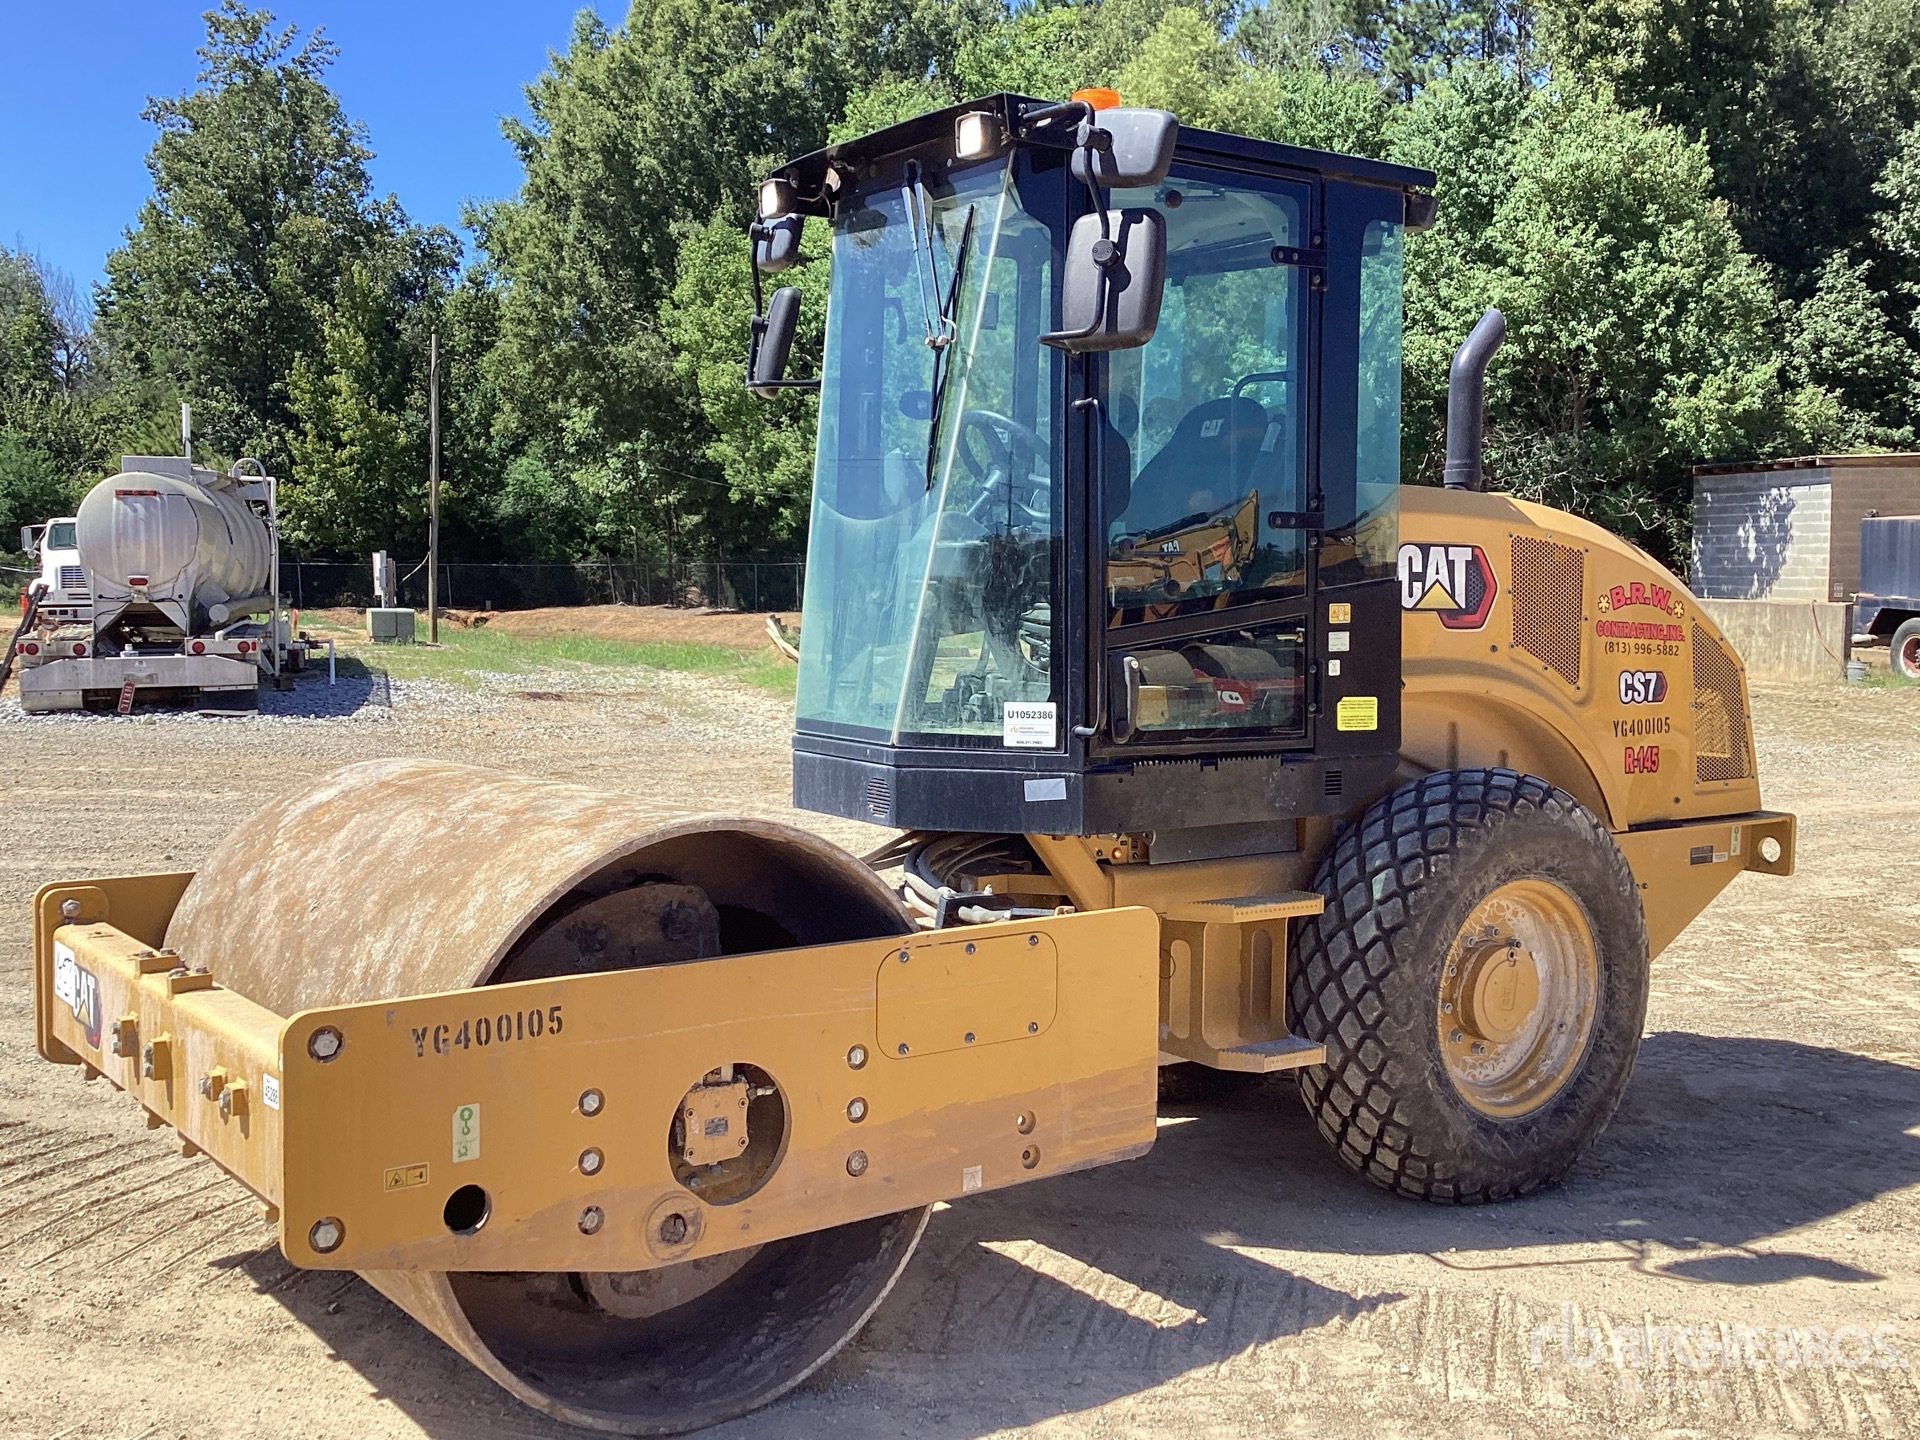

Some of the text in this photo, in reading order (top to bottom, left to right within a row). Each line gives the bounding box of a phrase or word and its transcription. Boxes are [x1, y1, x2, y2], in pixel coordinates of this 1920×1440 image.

[1200, 418, 1224, 437] CAT
[1398, 544, 1472, 609] CAT
[1609, 582, 1673, 616] B.R.W.
[1604, 641, 1680, 656] (813) 996-5882
[1619, 671, 1657, 703] CS7
[1007, 710, 1054, 719] U1052386
[1613, 716, 1671, 738] YG400105
[1625, 746, 1660, 774] R-145
[411, 1005, 563, 1058] YG400105
